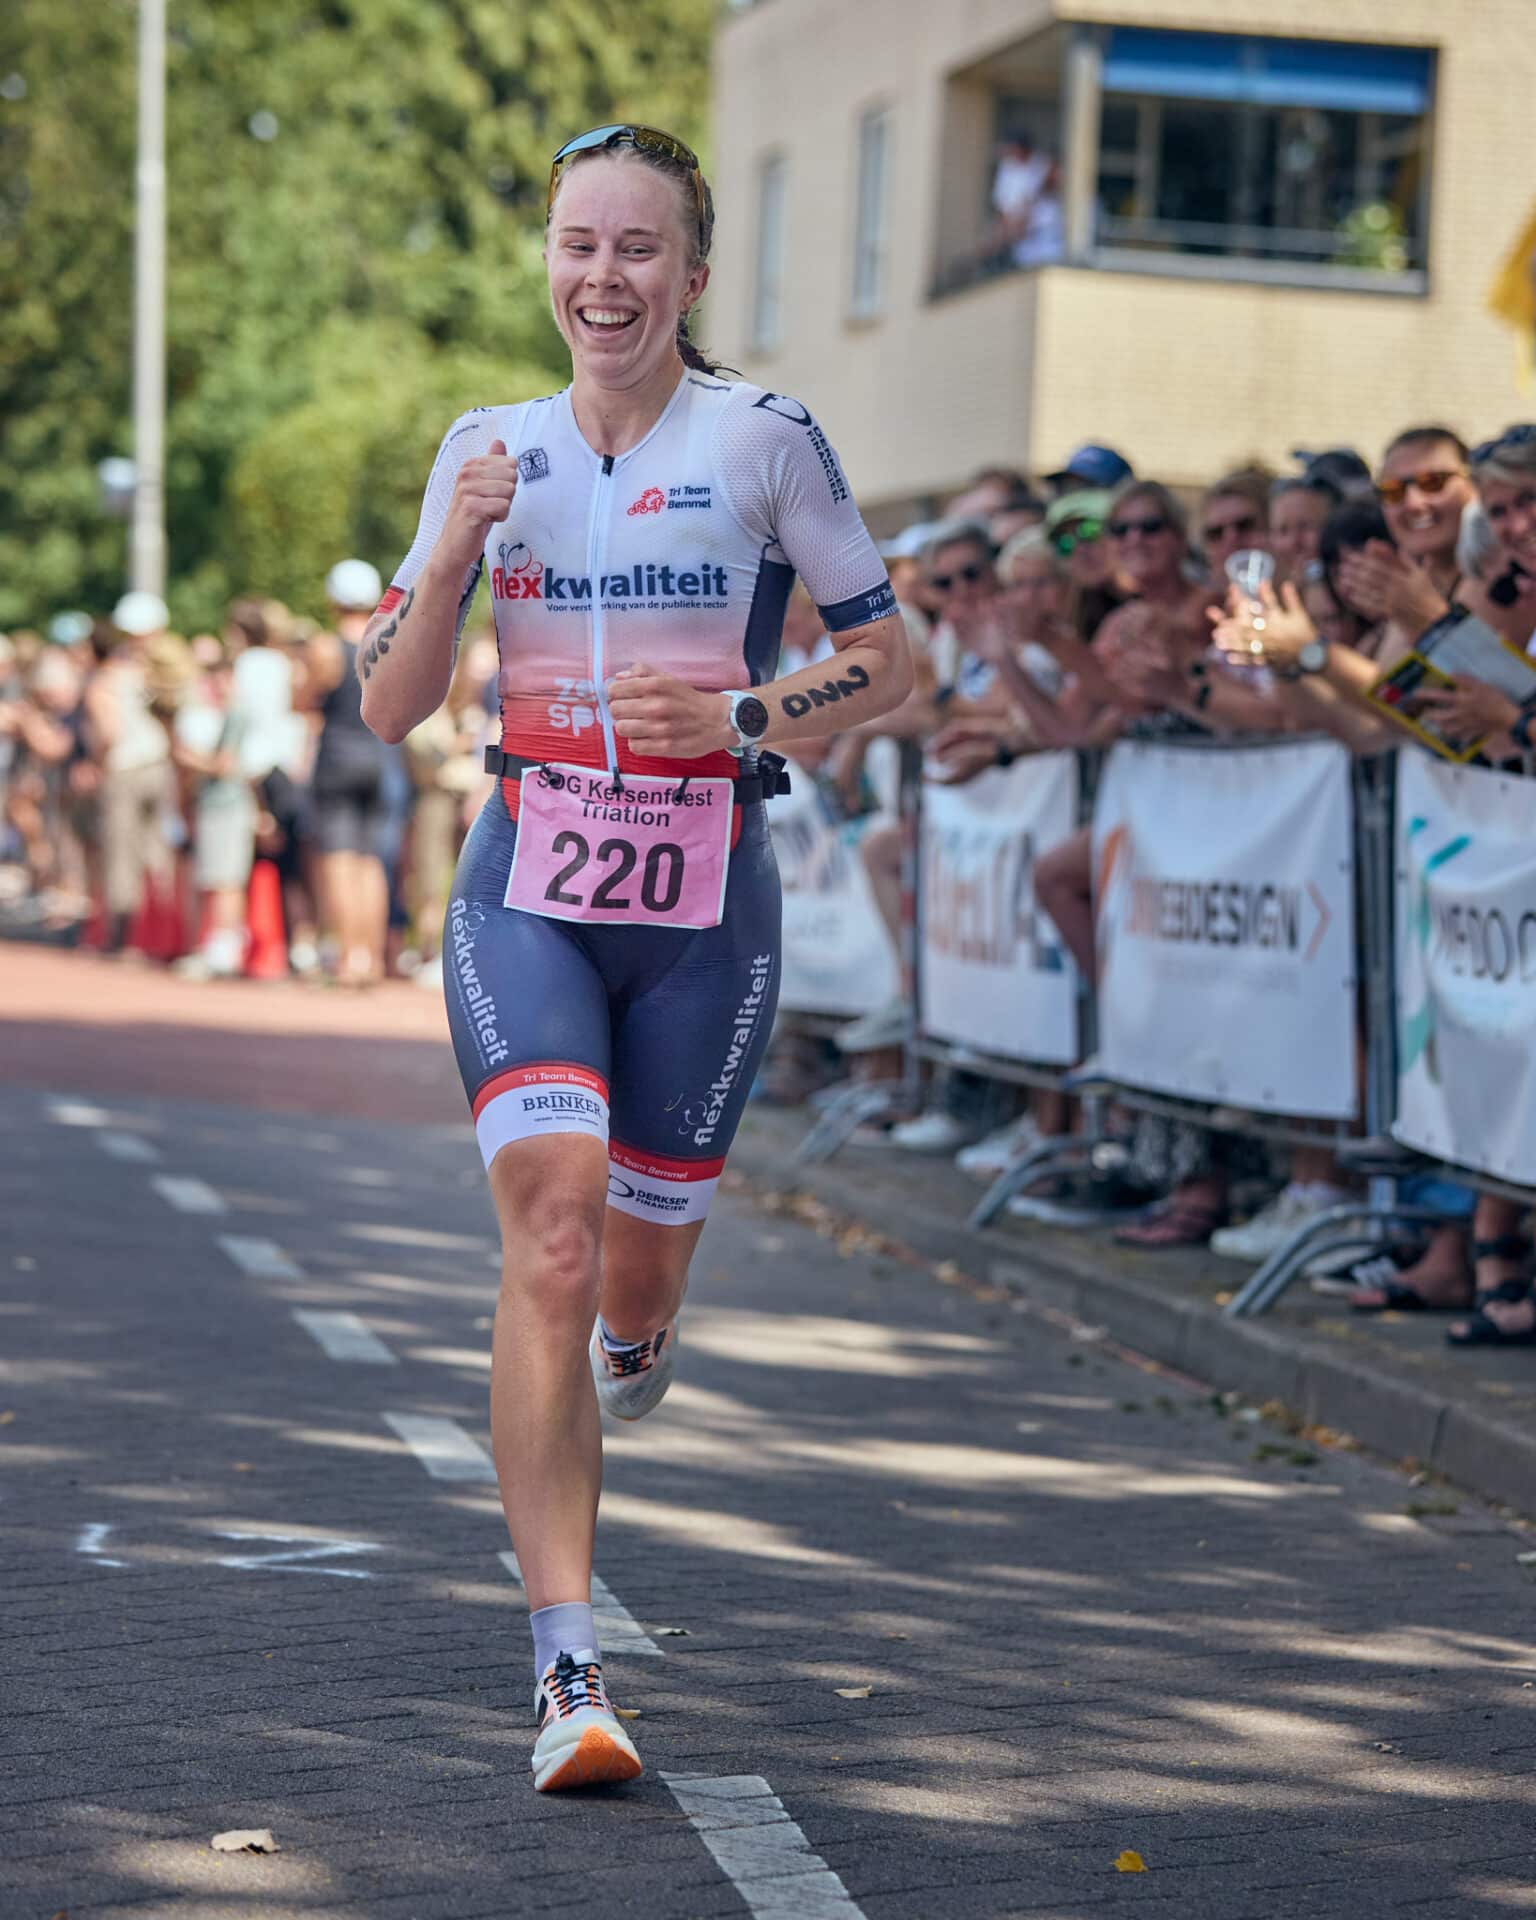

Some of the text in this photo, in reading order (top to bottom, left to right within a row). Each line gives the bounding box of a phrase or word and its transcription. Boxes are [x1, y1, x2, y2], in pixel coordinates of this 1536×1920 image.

[813, 426, 848, 501] DERKSEN
[668, 486, 711, 497] Tri Team
[667, 498, 712, 509] Bemmel
[492, 563, 728, 600] flexkwaliteit
[546, 603, 567, 611] Voor
[661, 600, 702, 611] publieke
[865, 592, 882, 608] Tri
[581, 799, 670, 827] Triatlon
[544, 830, 685, 912] 220
[451, 897, 510, 1065] flexkwaliteit
[694, 953, 770, 1146] flexkwaliteit
[523, 1073, 537, 1083] Tri
[539, 1072, 566, 1081] Team
[623, 1156, 647, 1172] Team
[647, 1166, 689, 1179] Bemmel
[636, 1189, 689, 1206] DERKSEN
